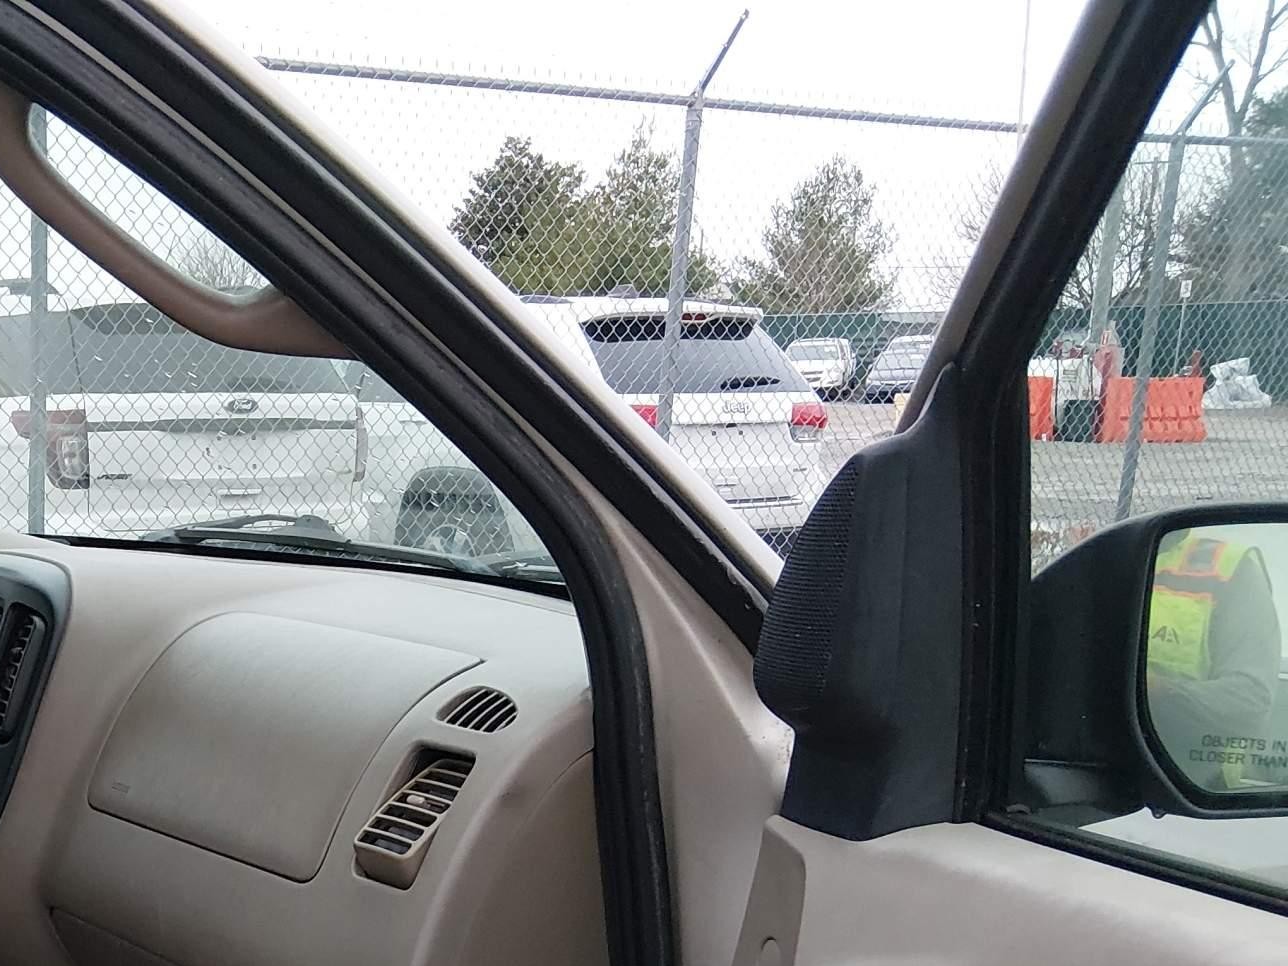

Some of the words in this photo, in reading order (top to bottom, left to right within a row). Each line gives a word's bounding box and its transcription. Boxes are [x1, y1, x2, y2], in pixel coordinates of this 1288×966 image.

[722, 400, 752, 416] Jeep
[1201, 734, 1266, 750] OBJECTS
[1272, 740, 1287, 752] IN
[1189, 749, 1246, 765] CLOSER
[1250, 754, 1288, 768] THAN
